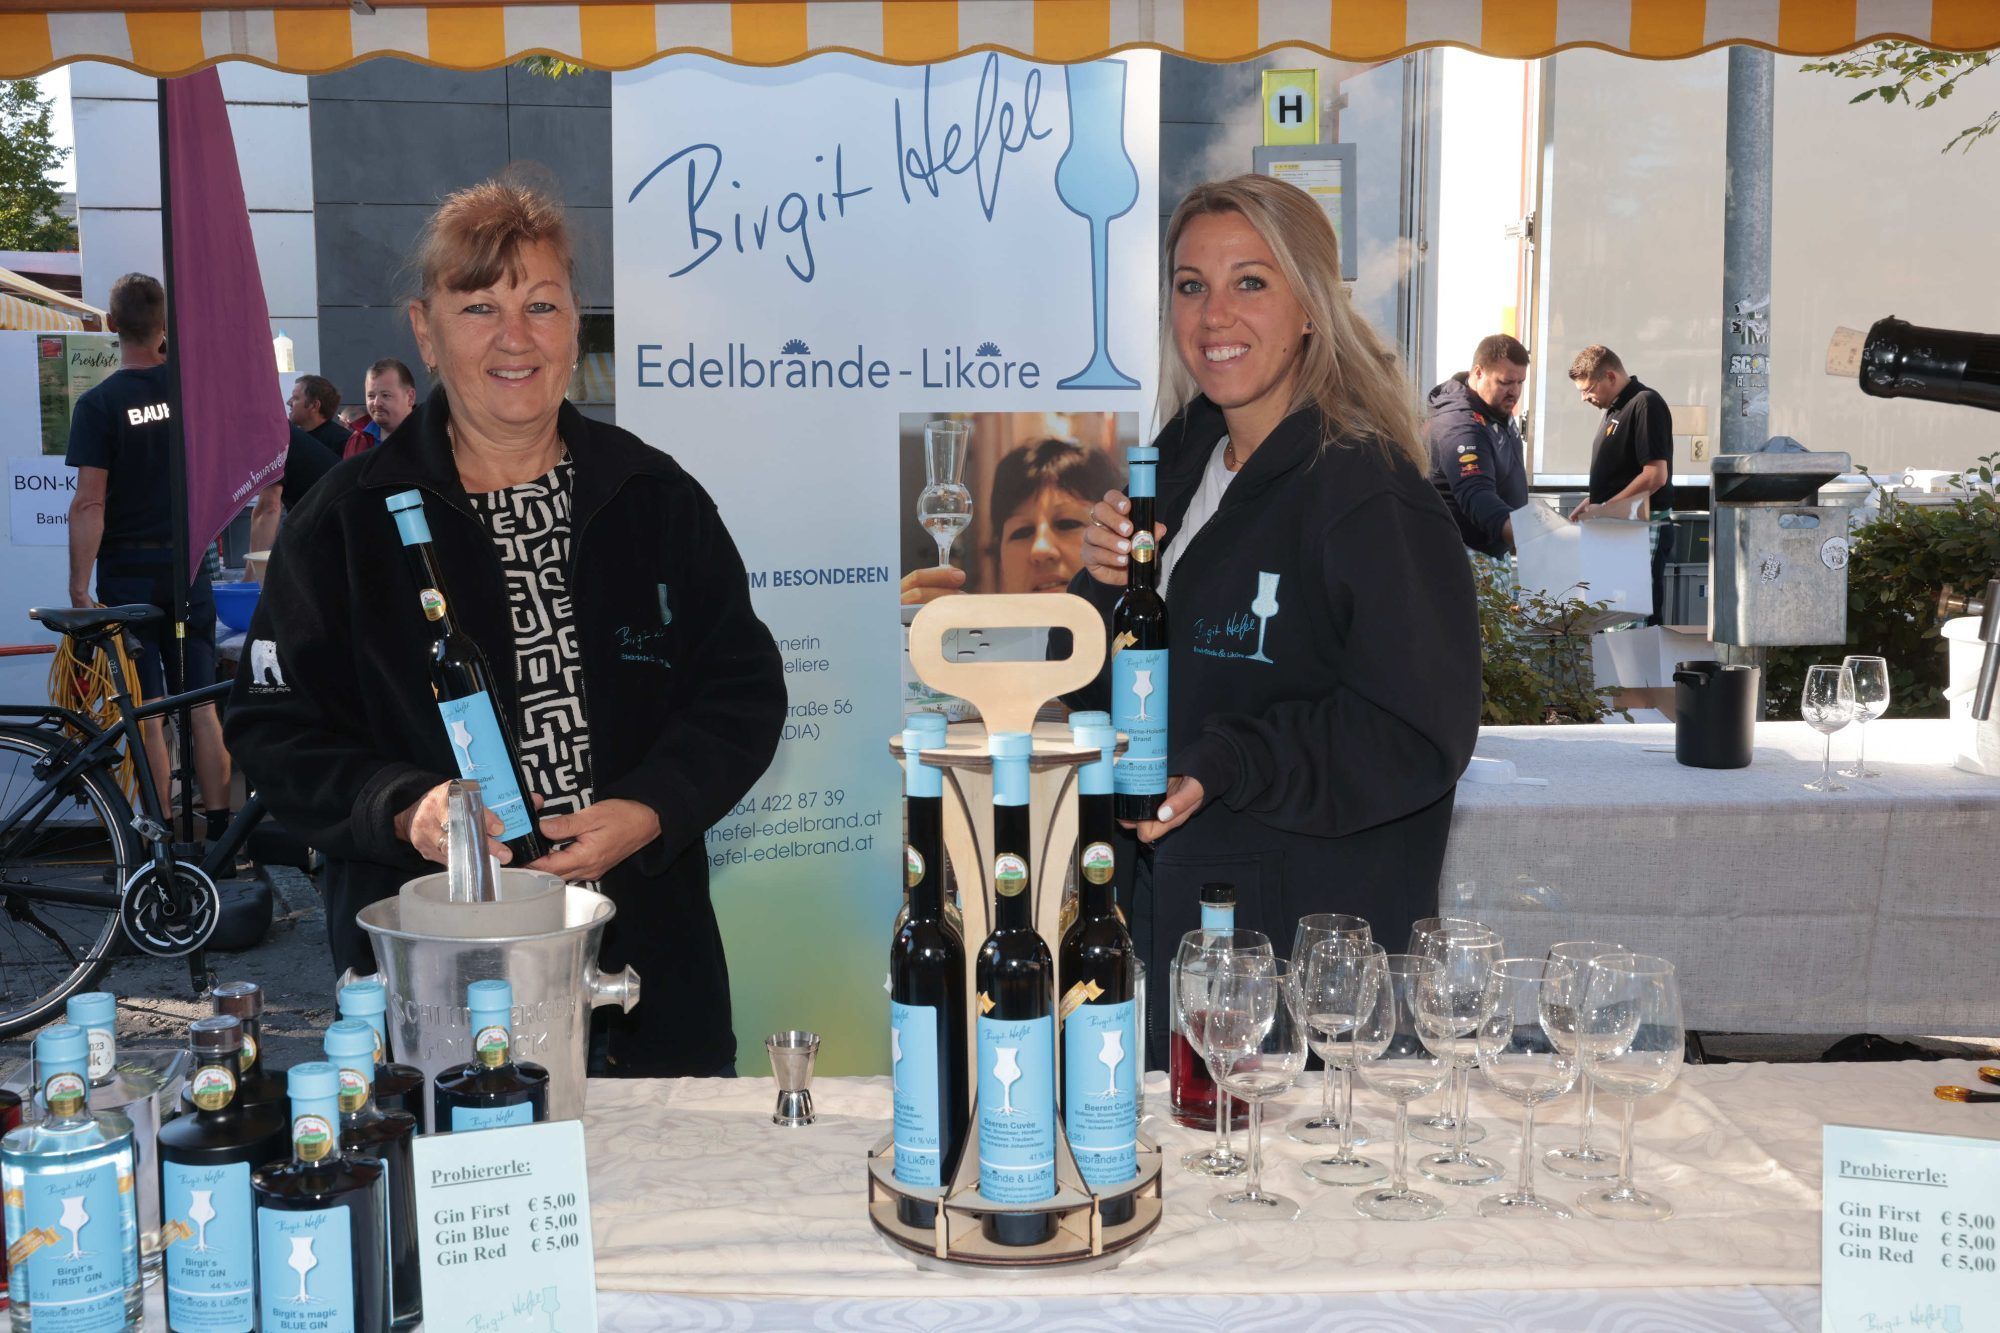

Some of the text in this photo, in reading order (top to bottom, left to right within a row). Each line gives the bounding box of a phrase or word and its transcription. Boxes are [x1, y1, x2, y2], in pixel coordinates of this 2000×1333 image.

[1279, 95, 1302, 123] H
[628, 52, 1053, 283] Birgit Hefel
[71, 352, 119, 368] Preisliste
[773, 566, 889, 587] BESONDEREN
[784, 658, 830, 673] eliere
[833, 699, 853, 715] 56
[761, 794, 793, 812] 422
[798, 791, 818, 808] 87
[823, 789, 845, 806] 39
[1084, 1103, 1113, 1111] Beeren
[984, 1117, 1009, 1129] Beeren
[917, 1136, 925, 1144] %
[431, 1160, 532, 1187] Probiererle:
[1018, 1174, 1025, 1183] &
[1839, 1160, 1948, 1187] Probiererle:
[434, 1192, 576, 1226] Gin First € 5,00
[1839, 1201, 1995, 1230] Gin First € 5,00
[435, 1212, 577, 1246] Gin Blue € 5,00
[1839, 1221, 1995, 1251] Gin Blue € 5,00
[437, 1232, 579, 1267] Gin Red € 5,00
[1839, 1242, 1996, 1273] Gin Red € 5,00
[52, 1272, 102, 1287] FIRST GIN
[181, 1268, 226, 1277] FIRST GIN
[234, 1280, 248, 1288] Vol
[308, 1308, 337, 1320] magic
[280, 1320, 328, 1330] BLUE GIN
